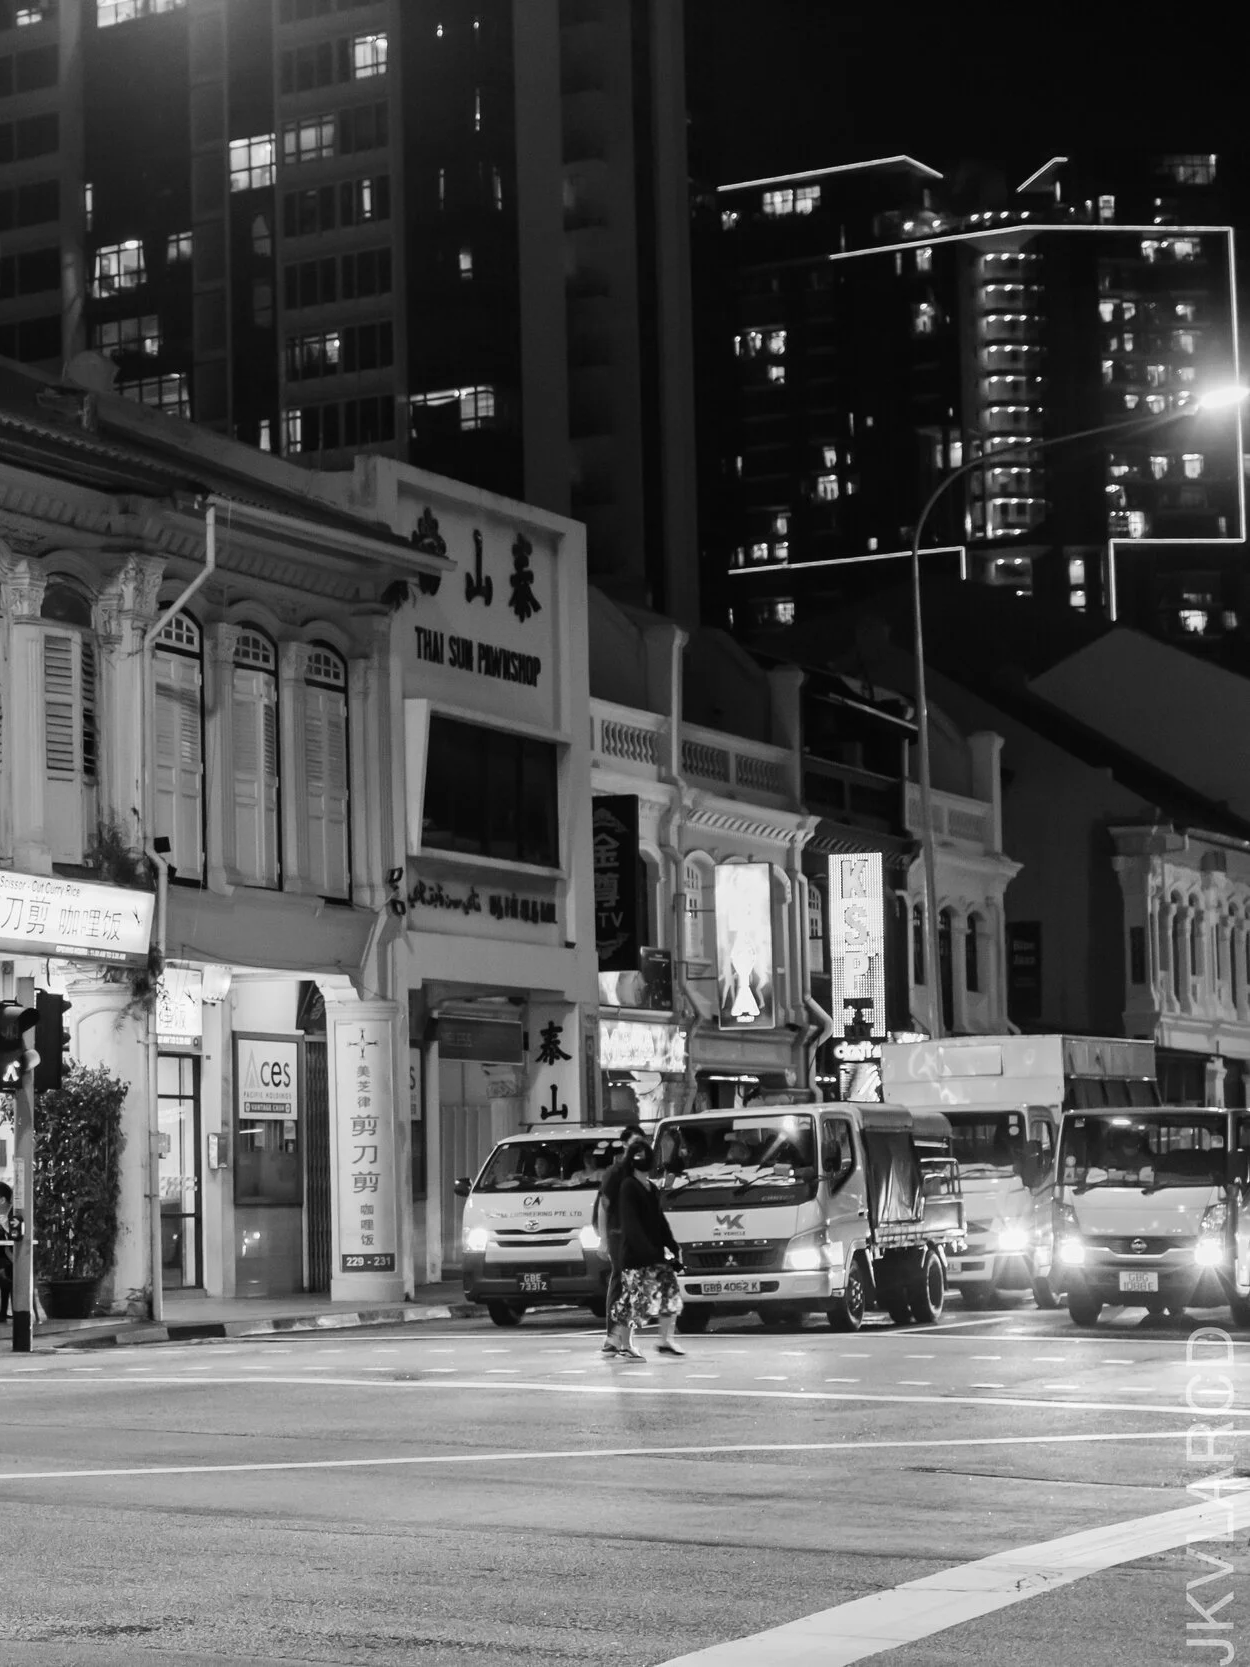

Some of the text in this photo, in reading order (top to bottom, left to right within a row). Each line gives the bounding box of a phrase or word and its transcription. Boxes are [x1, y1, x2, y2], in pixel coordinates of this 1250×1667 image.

[414, 625, 542, 688] THAI SUN PAWNSHOP
[350, 1114, 380, 1194] 剪刀剪
[345, 1255, 365, 1268] 229
[373, 1255, 392, 1267] 231
[523, 1273, 542, 1283] GBE
[519, 1282, 548, 1291] 7331Z
